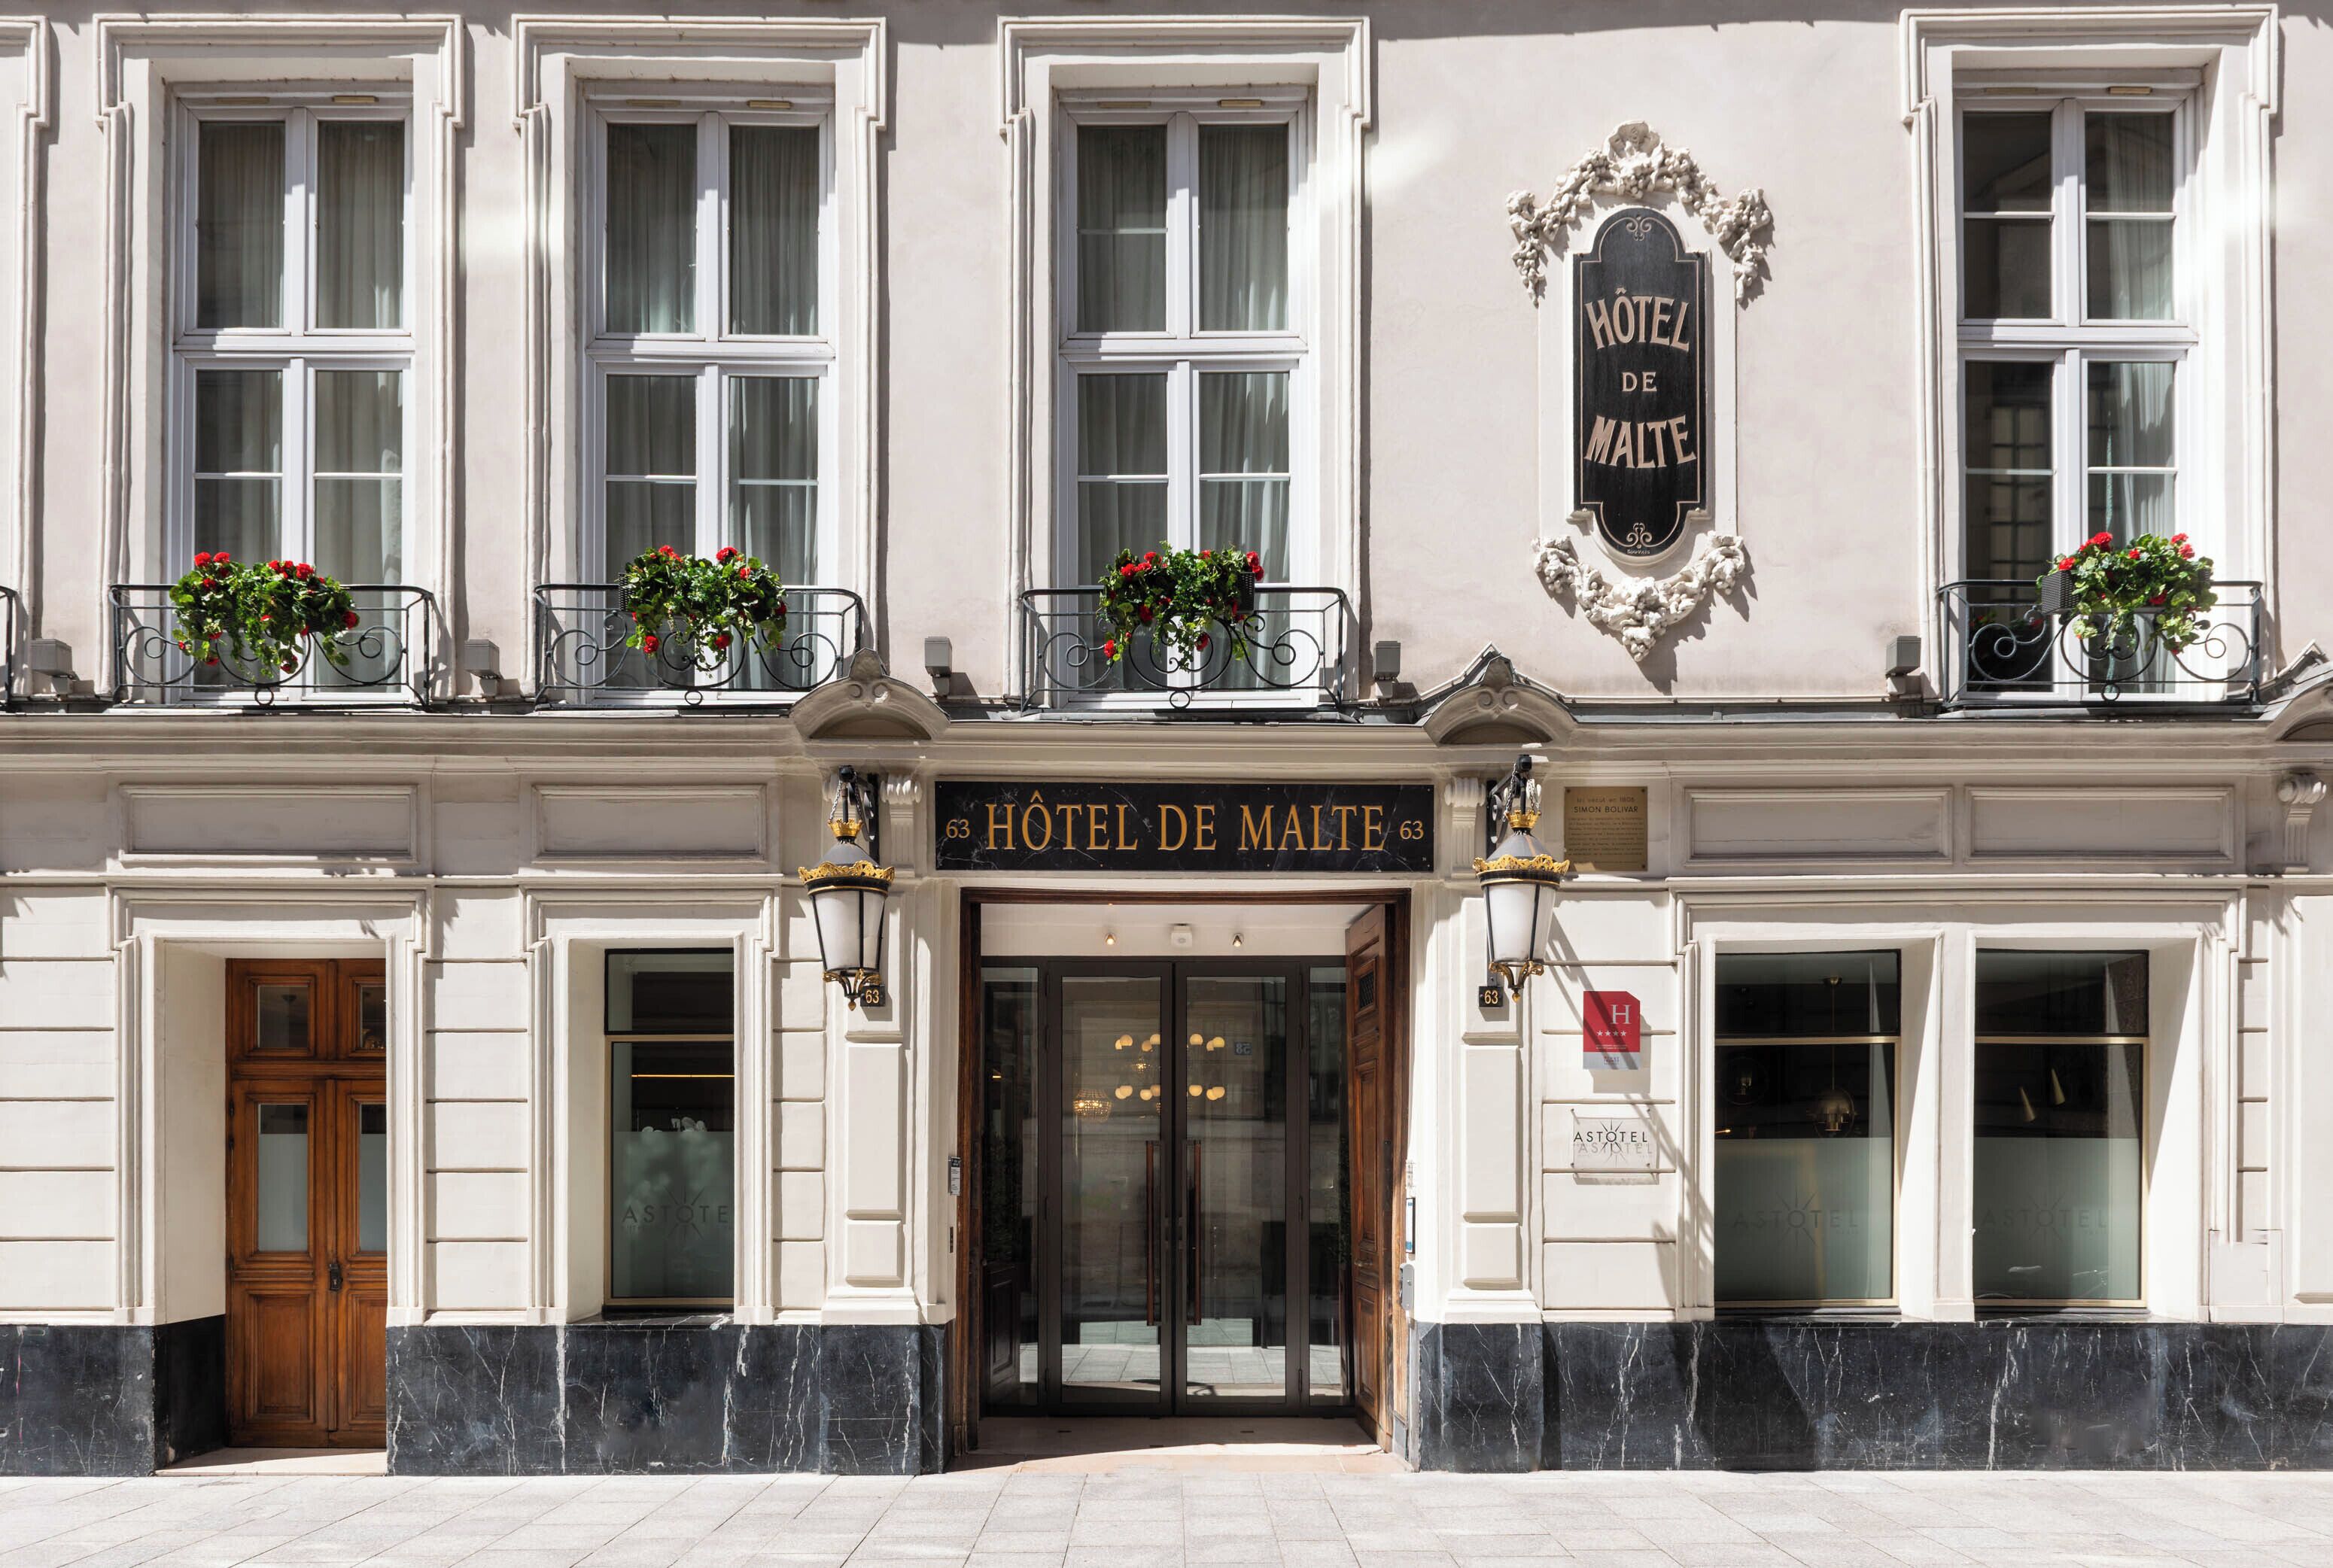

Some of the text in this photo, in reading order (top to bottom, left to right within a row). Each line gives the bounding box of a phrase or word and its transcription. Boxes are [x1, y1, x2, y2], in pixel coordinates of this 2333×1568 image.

[1584, 287, 1690, 352] HÔTEL
[1621, 371, 1658, 392] DE
[1583, 415, 1698, 469] MALTE
[945, 789, 1425, 852] 63 HÔTEL DE MALTE 63
[865, 989, 880, 1004] 63
[1484, 989, 1498, 1004] 63
[1610, 1004, 1632, 1025] H
[1573, 1131, 1648, 1143] ASTOTEL
[1733, 1209, 1858, 1229] ASTOTEL
[1980, 1208, 2108, 1229] ASTOTEL
